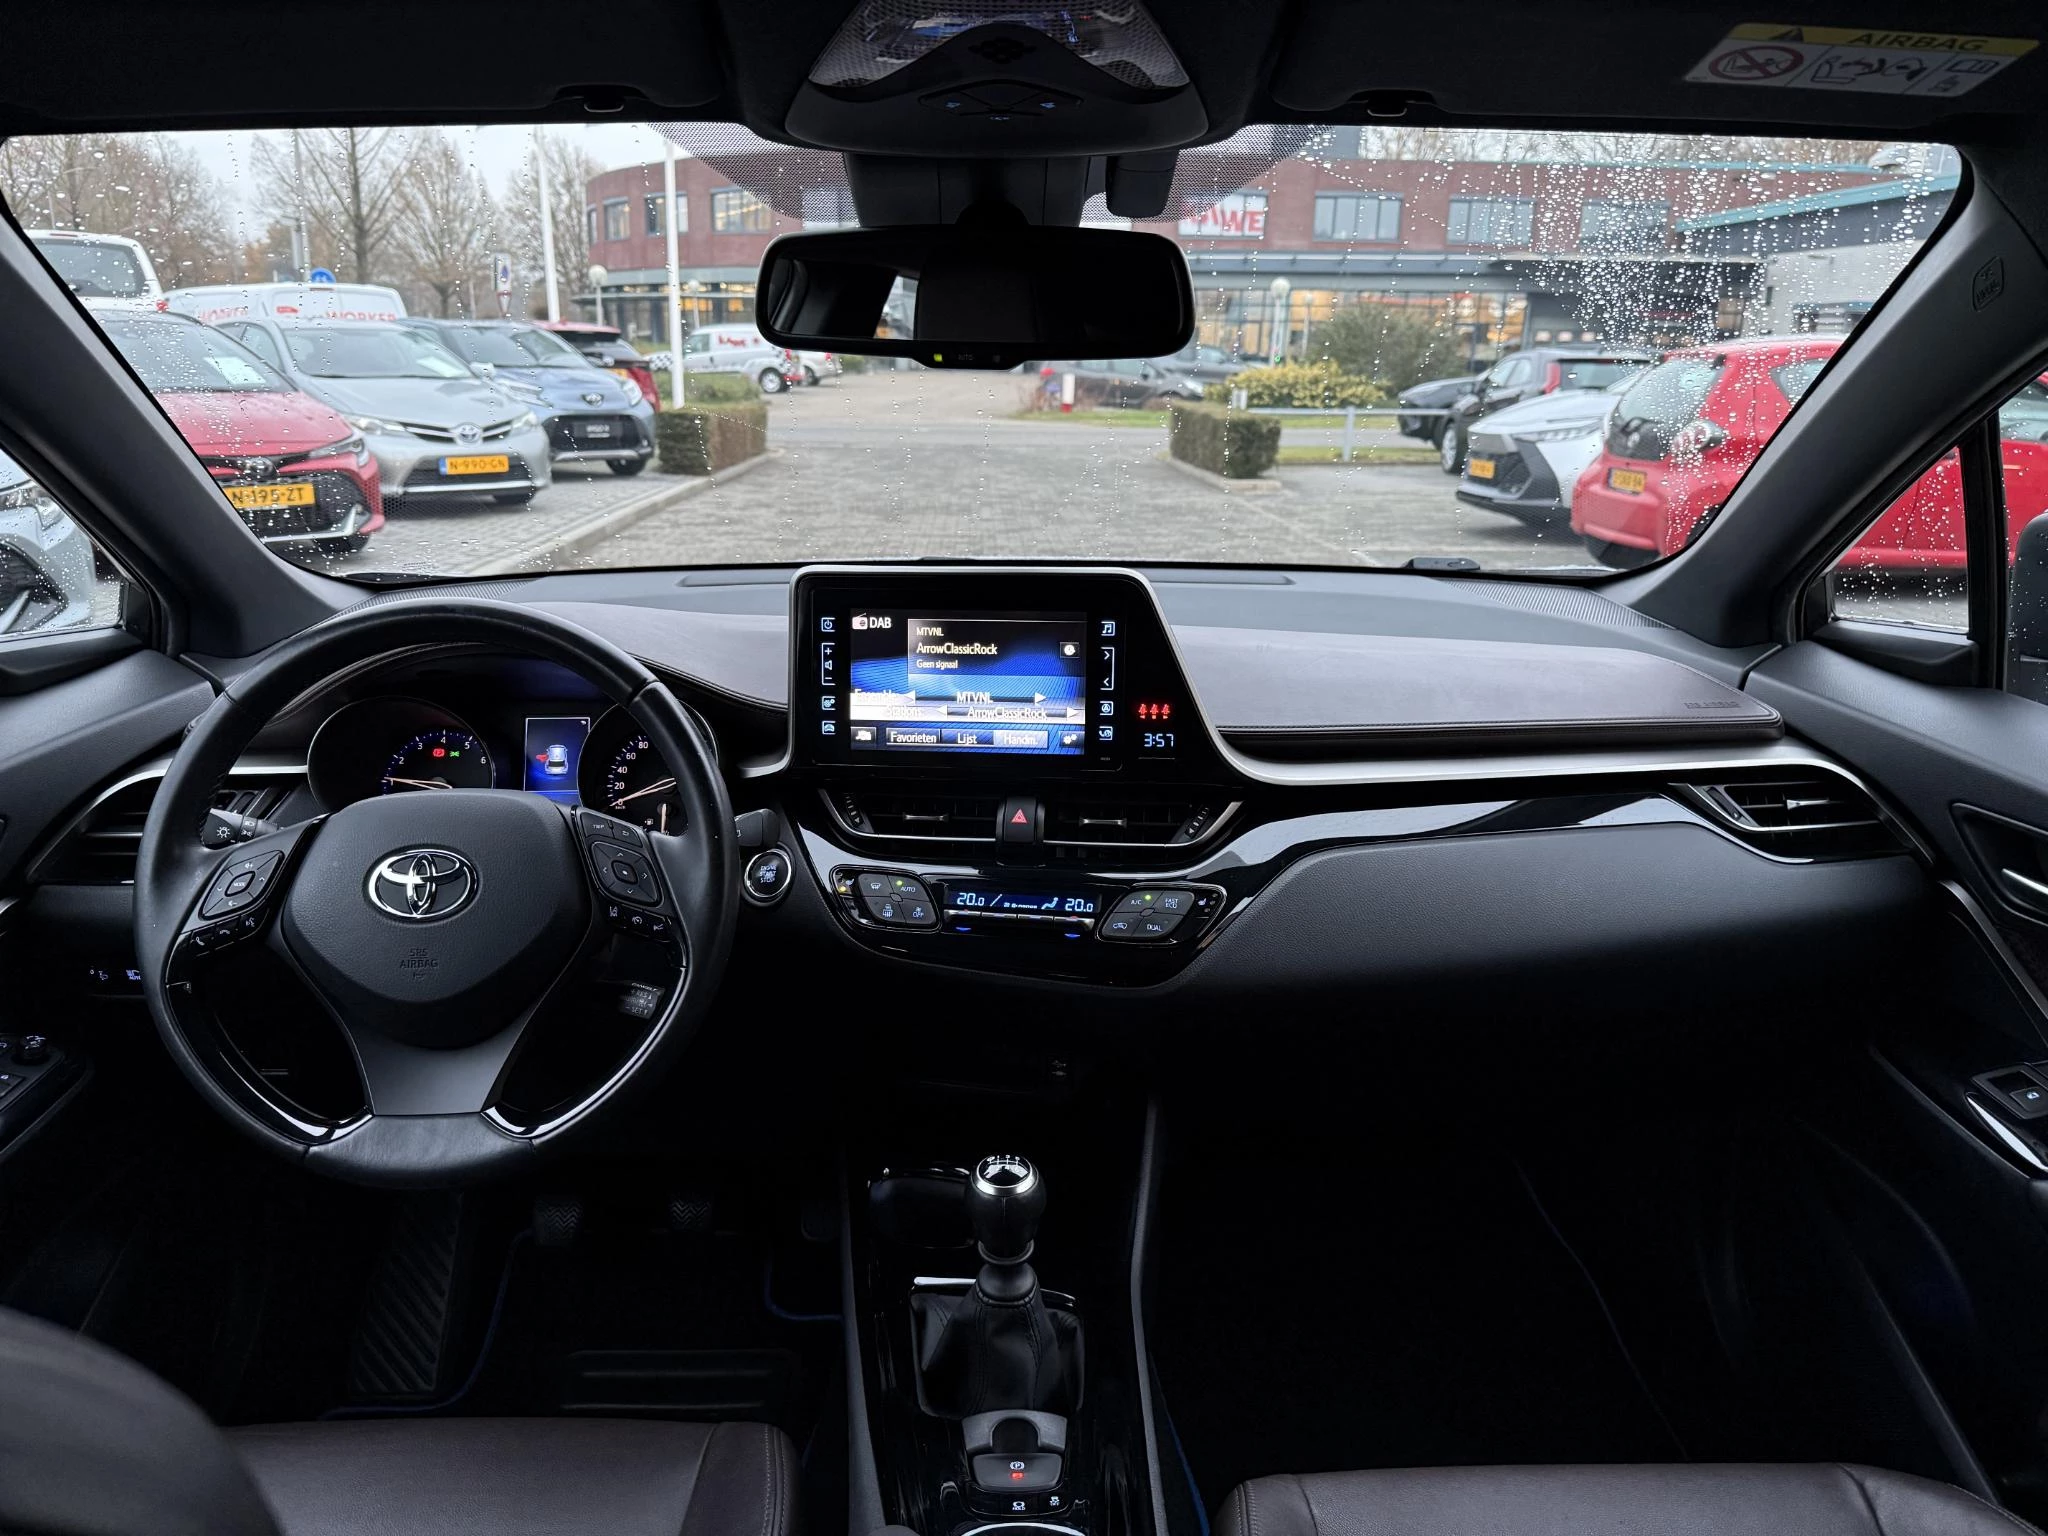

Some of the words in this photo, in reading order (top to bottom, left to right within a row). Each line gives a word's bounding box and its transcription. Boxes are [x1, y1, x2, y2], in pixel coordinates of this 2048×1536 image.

[1847, 32, 1989, 51] AIRBAG
[869, 617, 892, 629] DAB
[916, 627, 944, 636] MTVNL
[916, 643, 998, 655] ArrowClassicRock
[916, 659, 935, 668] Geen
[935, 659, 958, 670] signaal
[956, 691, 994, 704] MTVNL
[967, 707, 1048, 719] ArrowClassicRock
[890, 732, 937, 744] Favorieten
[957, 732, 977, 745] Lijst
[1004, 734, 1038, 745] Handm.
[1144, 733, 1174, 747] 3:57
[464, 741, 470, 749] 5
[638, 741, 649, 749] 80
[399, 757, 405, 765] 2
[481, 756, 487, 764] 6
[617, 766, 628, 774] 40
[614, 781, 625, 790] 20
[956, 892, 985, 906] 20.0
[1064, 898, 1094, 912] 20.0
[409, 948, 428, 957] SRS
[400, 959, 439, 969] AIRBAG
